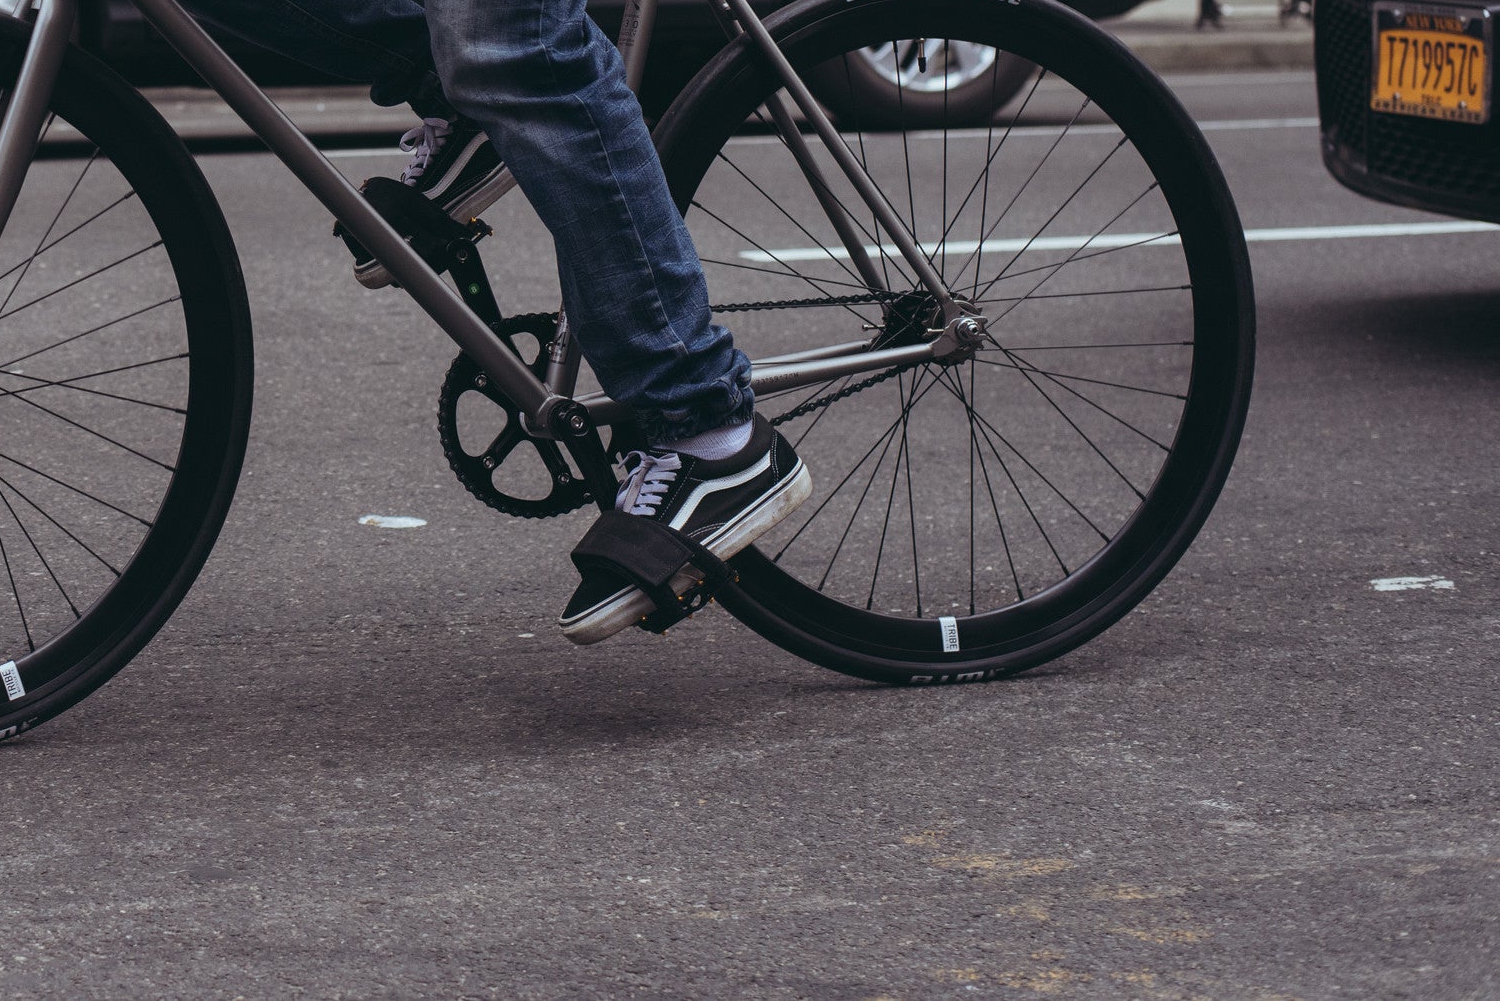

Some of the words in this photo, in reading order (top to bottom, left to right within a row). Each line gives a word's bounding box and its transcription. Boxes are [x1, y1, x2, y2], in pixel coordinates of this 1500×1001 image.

[1387, 36, 1479, 96] T719957C
[947, 623, 958, 650] TRIBE
[2, 669, 18, 697] TRIBE
